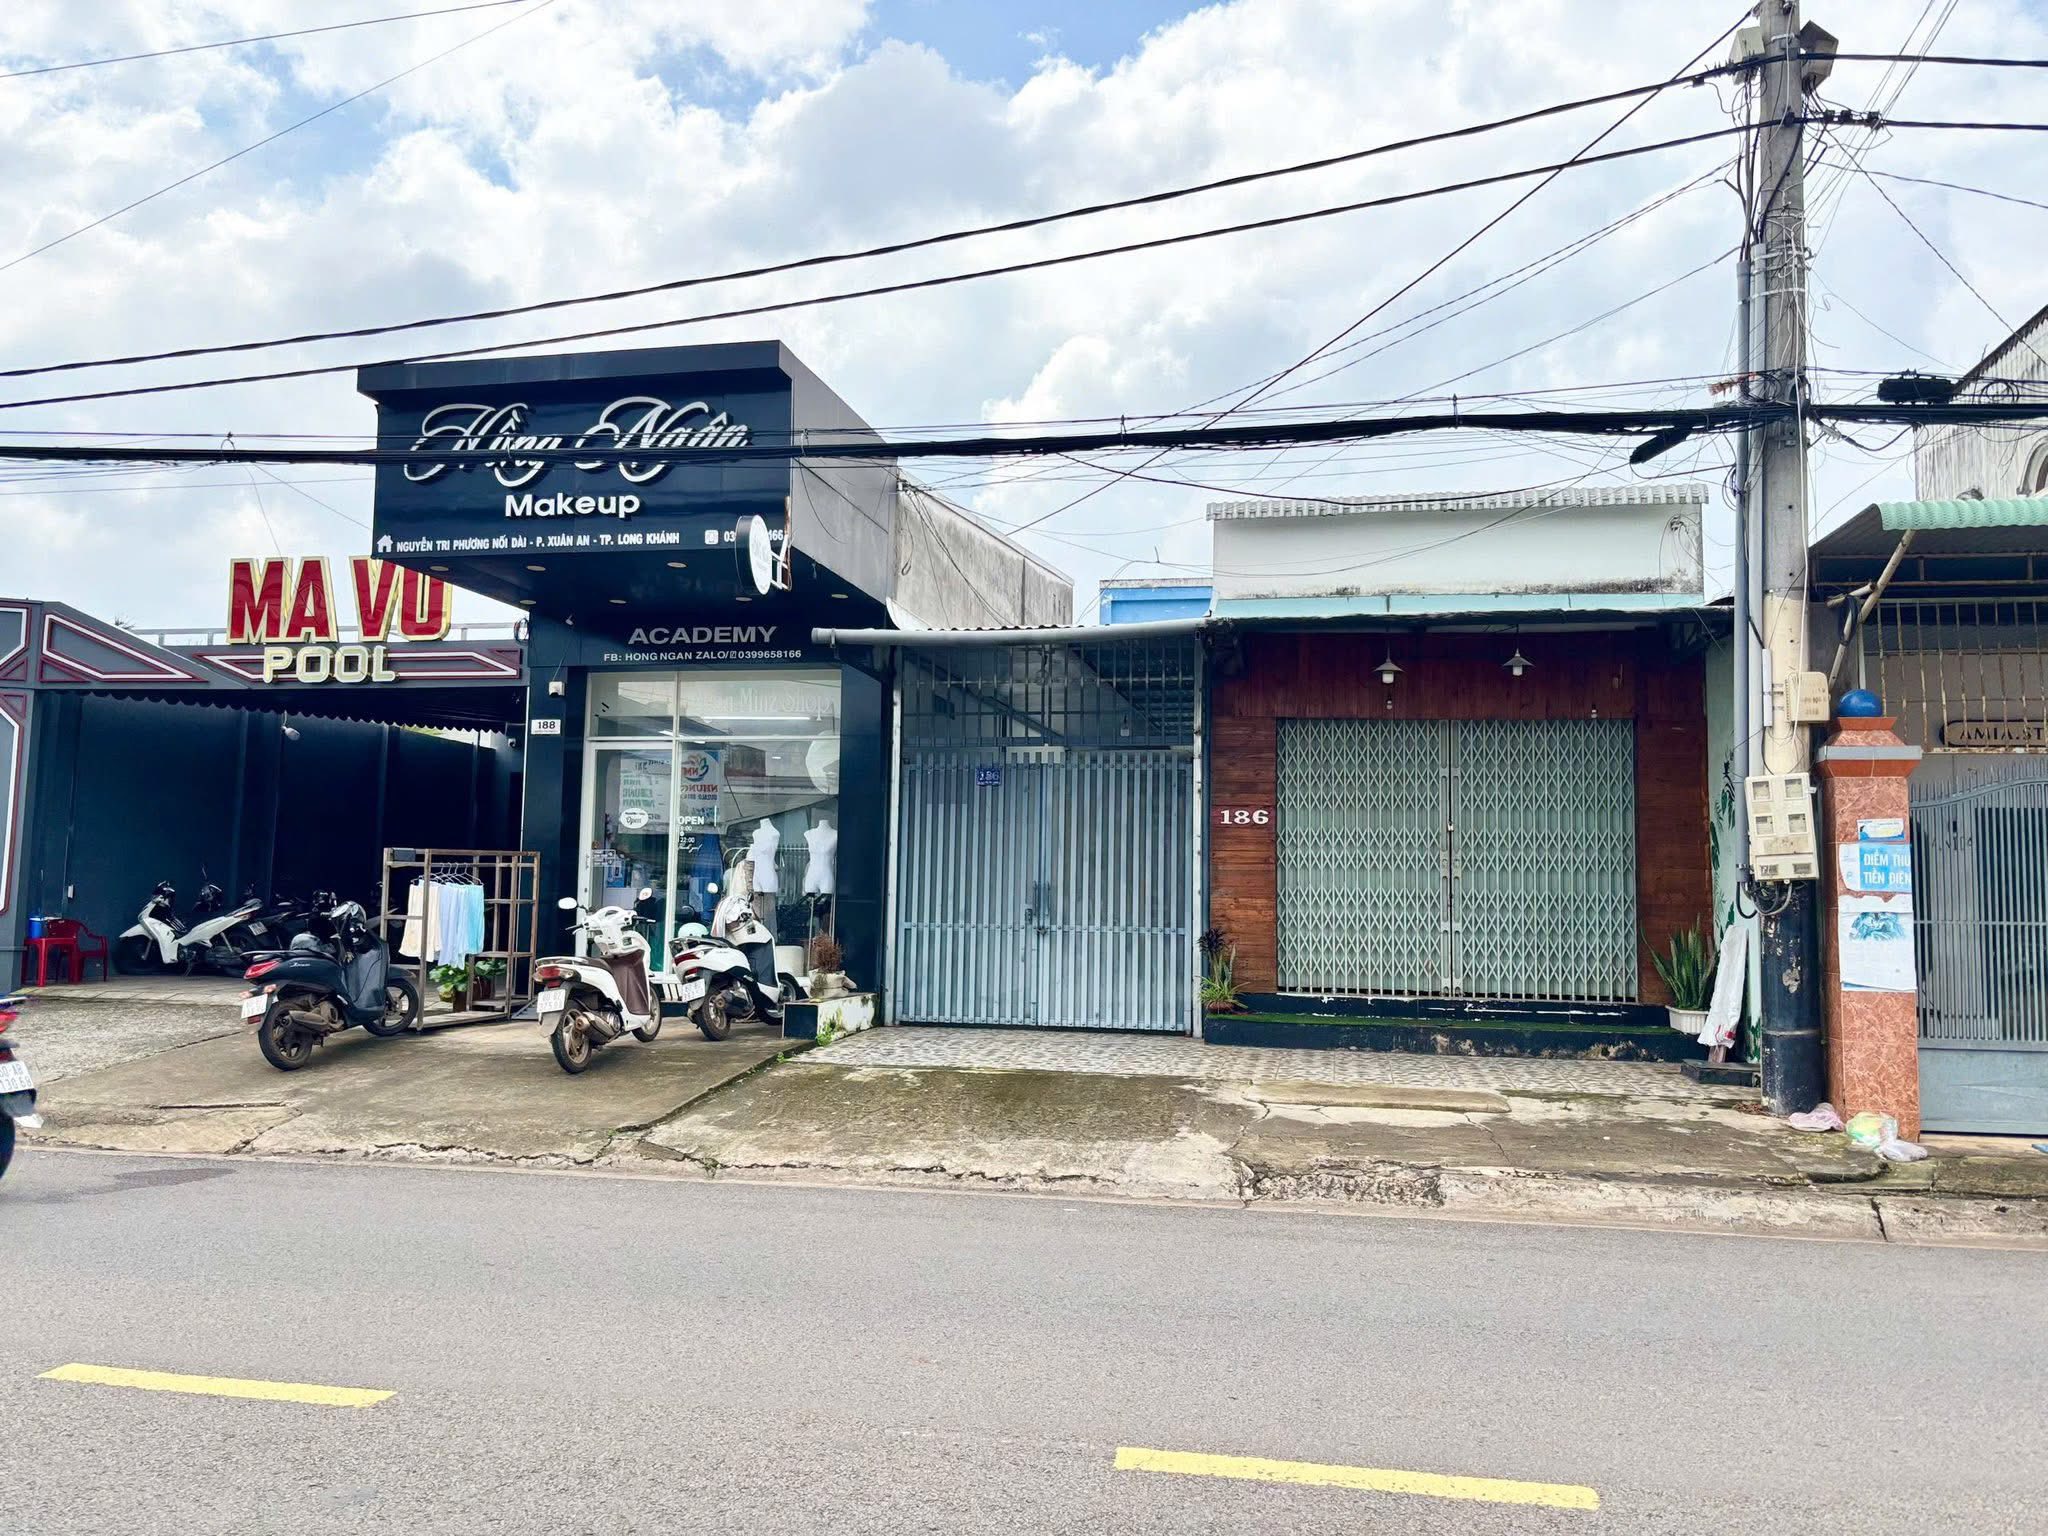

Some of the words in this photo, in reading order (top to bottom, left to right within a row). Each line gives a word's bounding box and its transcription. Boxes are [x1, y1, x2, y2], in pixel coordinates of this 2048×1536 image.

[505, 492, 640, 518] Makeup
[396, 536, 433, 552] NGUYỄN
[436, 540, 450, 551] TRI
[453, 537, 489, 550] PHƯƠNG
[492, 534, 508, 549] NỐI
[511, 535, 527, 548] DÀI
[536, 536, 545, 547] P.
[547, 533, 573, 547] XUÂN
[576, 535, 590, 546] AN
[599, 534, 614, 545] TP.
[618, 533, 642, 545] LONG
[646, 530, 680, 544] KHÁNH
[226, 556, 339, 644] MA
[628, 626, 777, 645] ACADEMY
[263, 645, 399, 684] POOL
[603, 653, 622, 662] FB:
[625, 652, 658, 661] HONG
[660, 651, 692, 660] NGAN
[537, 720, 556, 729] 188
[678, 816, 705, 825] OPEN
[1220, 809, 1269, 825] 186
